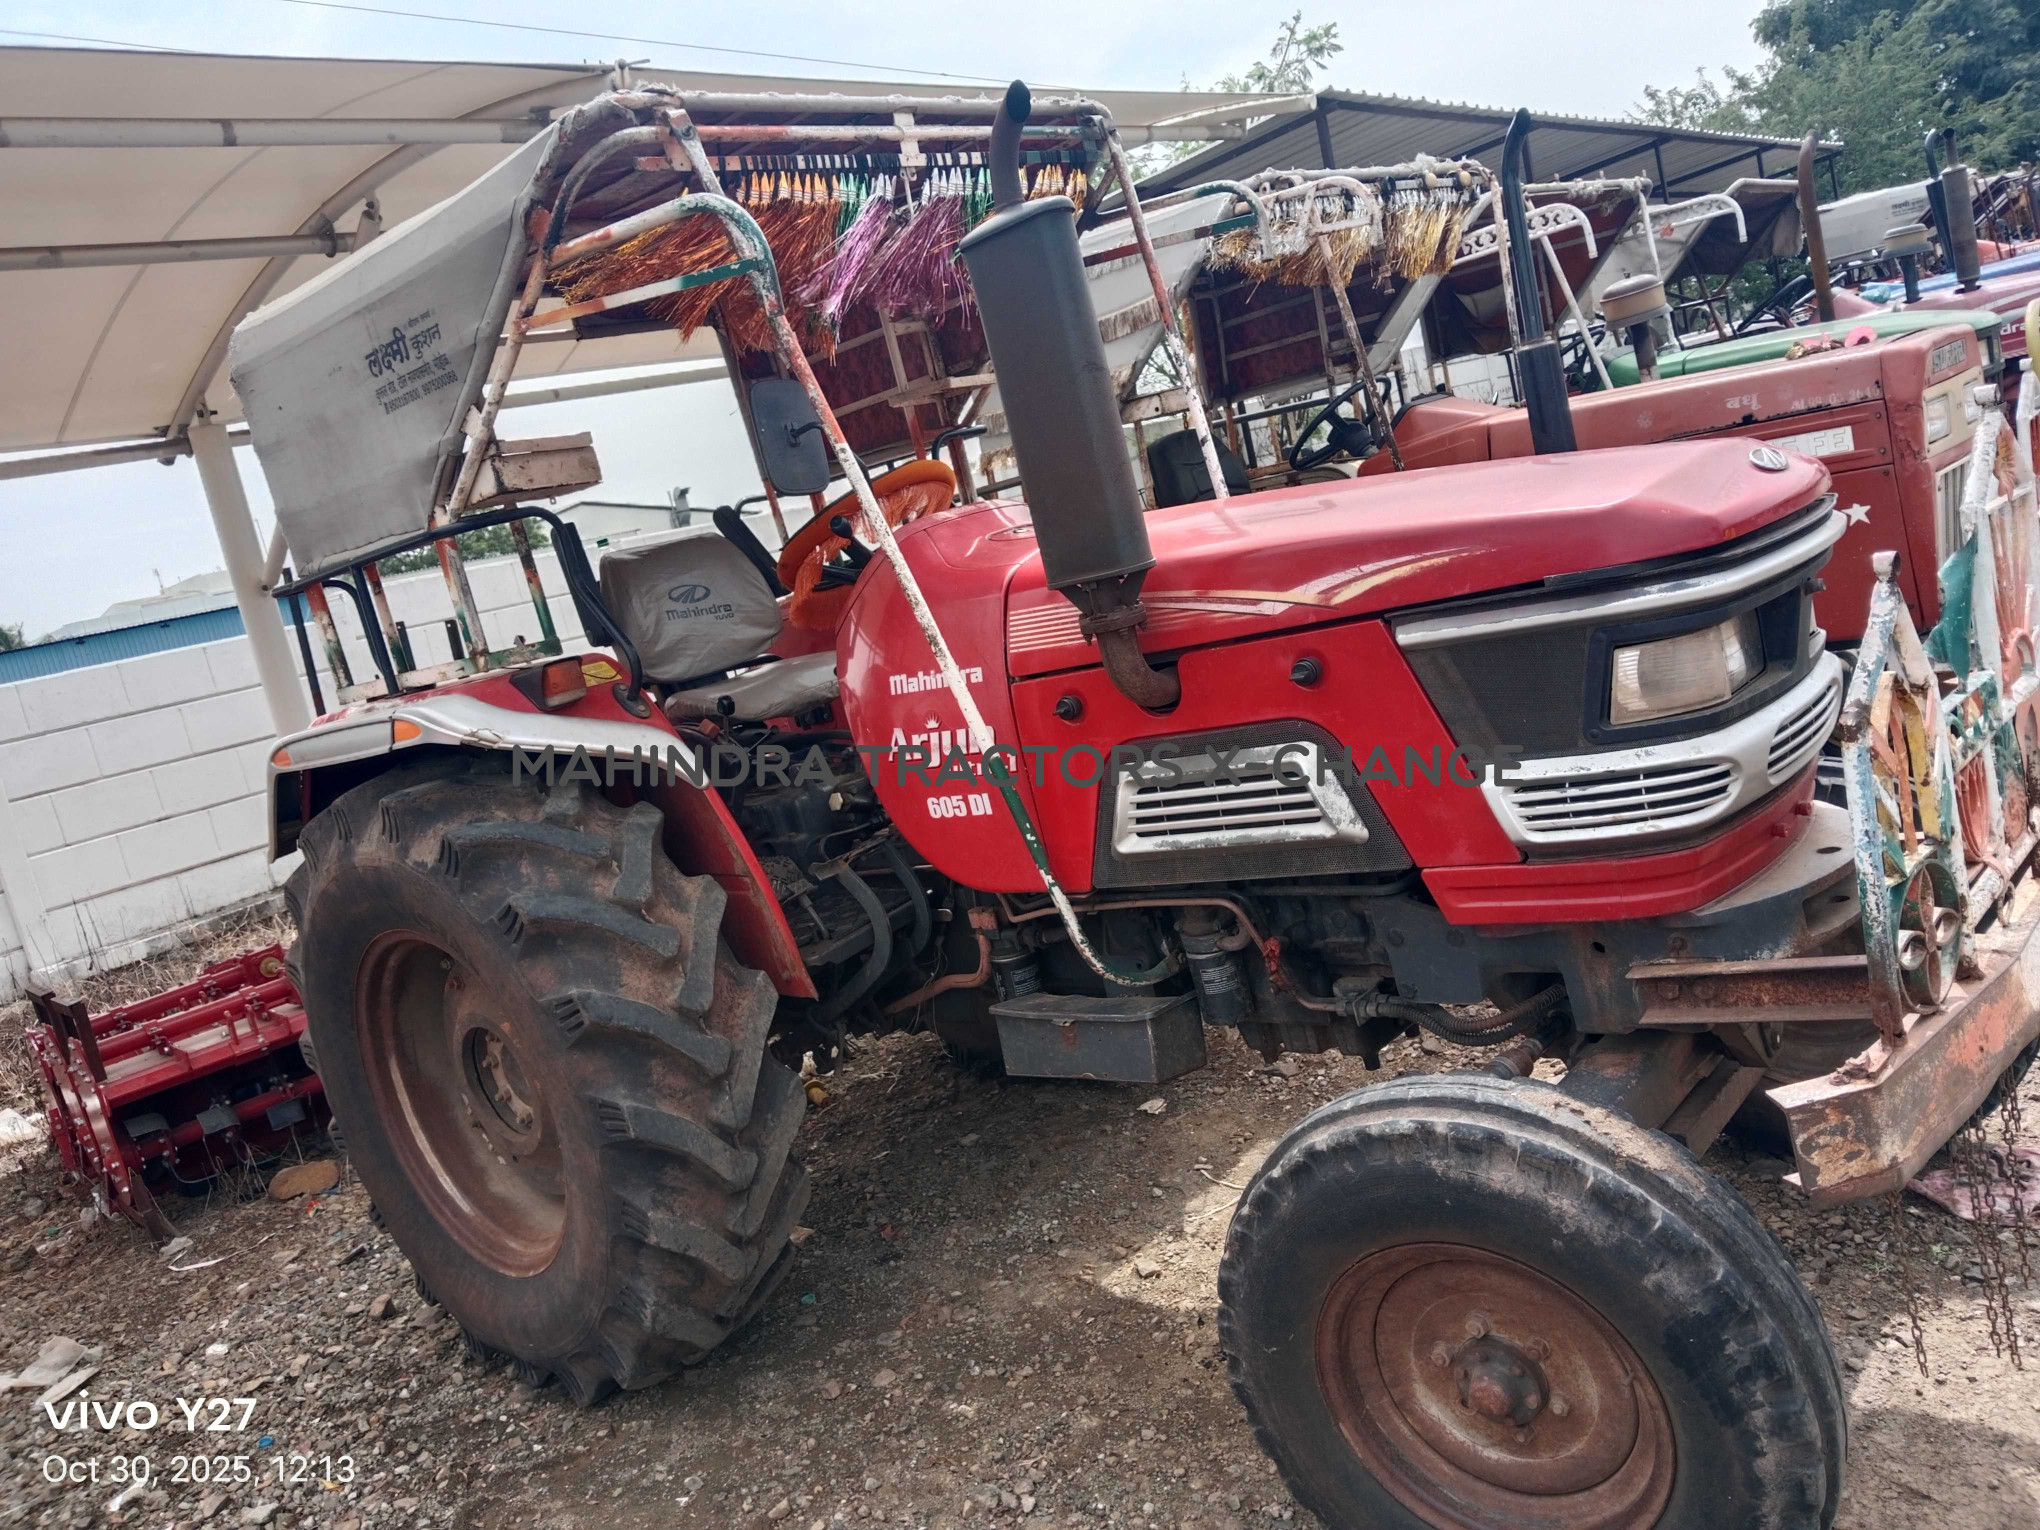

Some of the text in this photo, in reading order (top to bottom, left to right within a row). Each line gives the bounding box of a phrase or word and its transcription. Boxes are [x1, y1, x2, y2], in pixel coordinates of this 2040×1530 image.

[365, 323, 442, 377] लक्ष्मी कुशन
[666, 603, 732, 621] Mahindra
[889, 666, 983, 696] Mahinra
[927, 792, 993, 819] 605 DI
